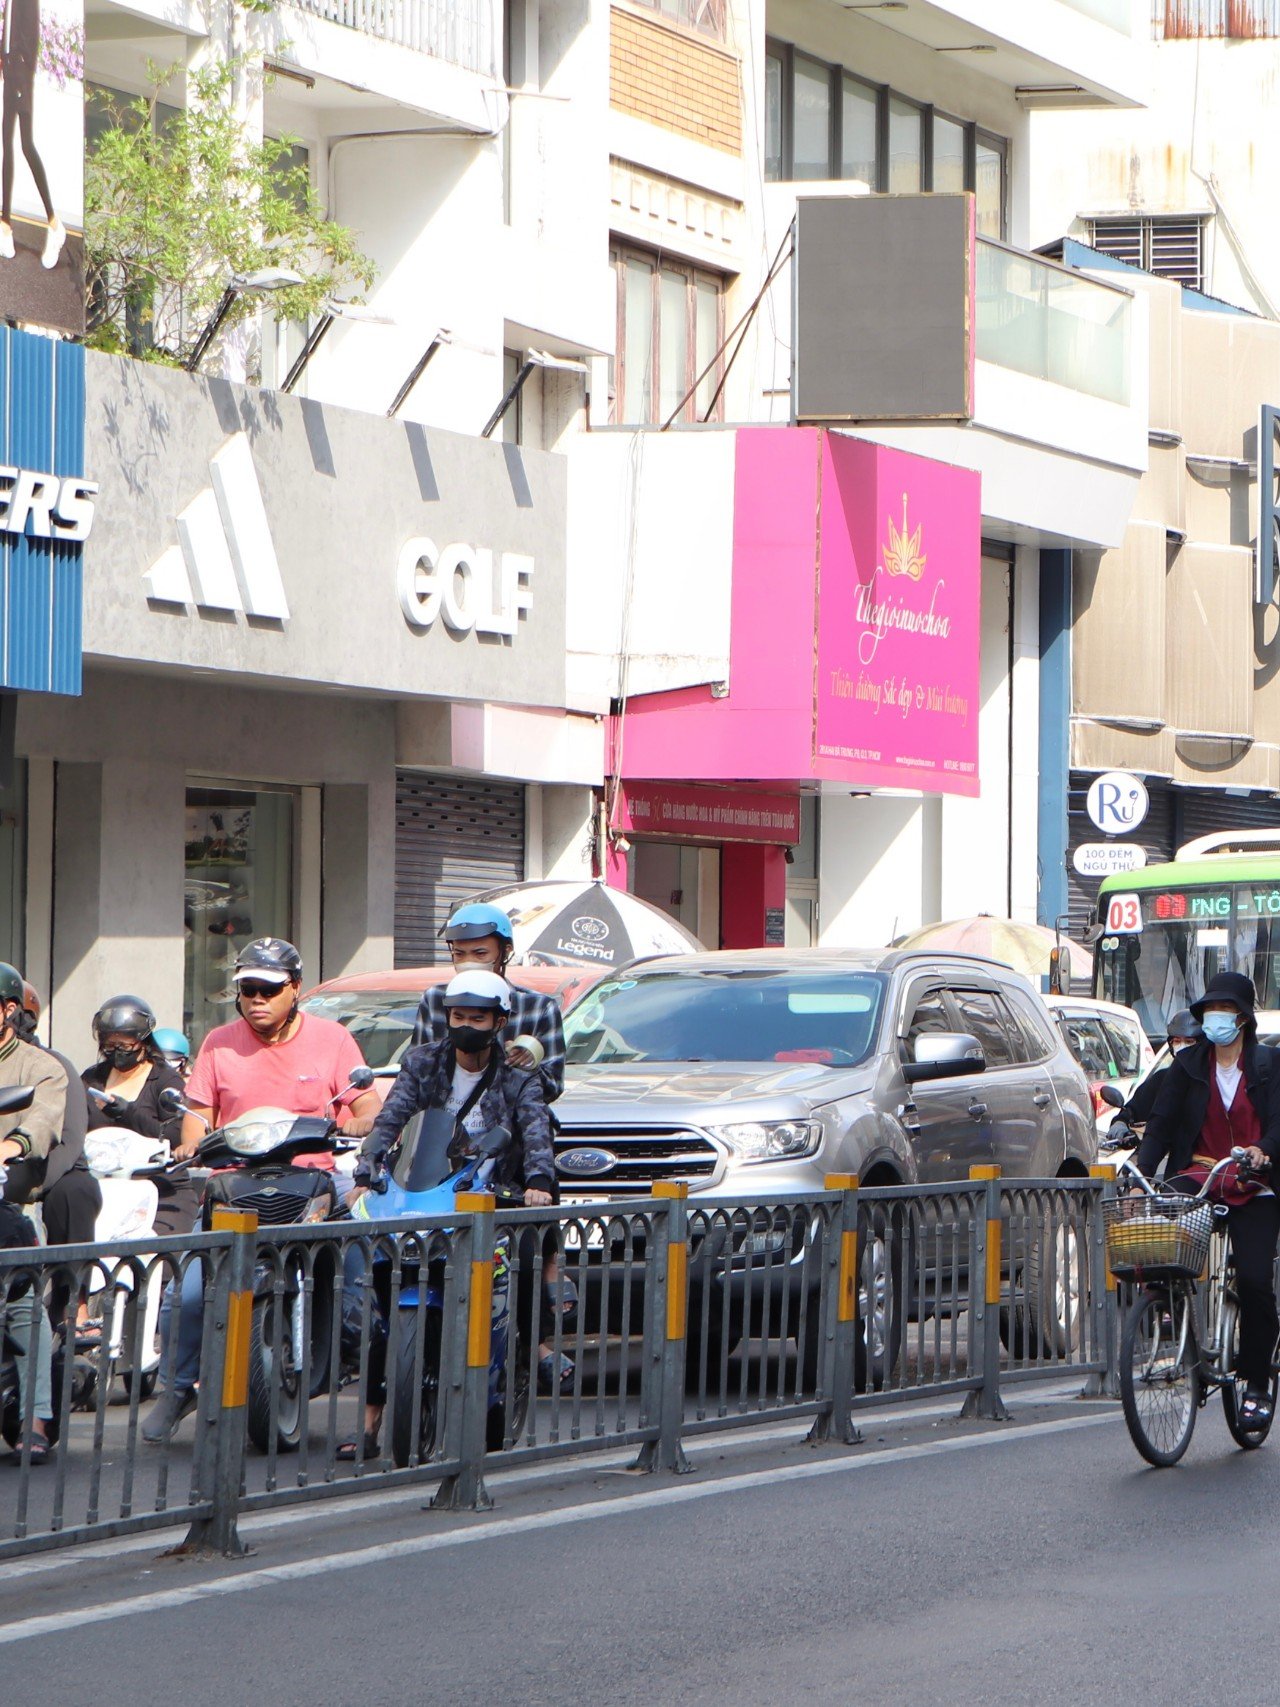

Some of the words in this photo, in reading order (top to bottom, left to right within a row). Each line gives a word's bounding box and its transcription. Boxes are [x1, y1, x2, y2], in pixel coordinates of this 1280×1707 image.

[397, 536, 536, 635] GOLF
[831, 667, 854, 698] Thiên
[898, 677, 912, 719] đẹp
[1086, 850, 1105, 859] 100
[1110, 901, 1137, 930] 03
[1156, 893, 1187, 918] 03
[557, 938, 615, 960] Legend
[568, 1153, 599, 1166] Ford
